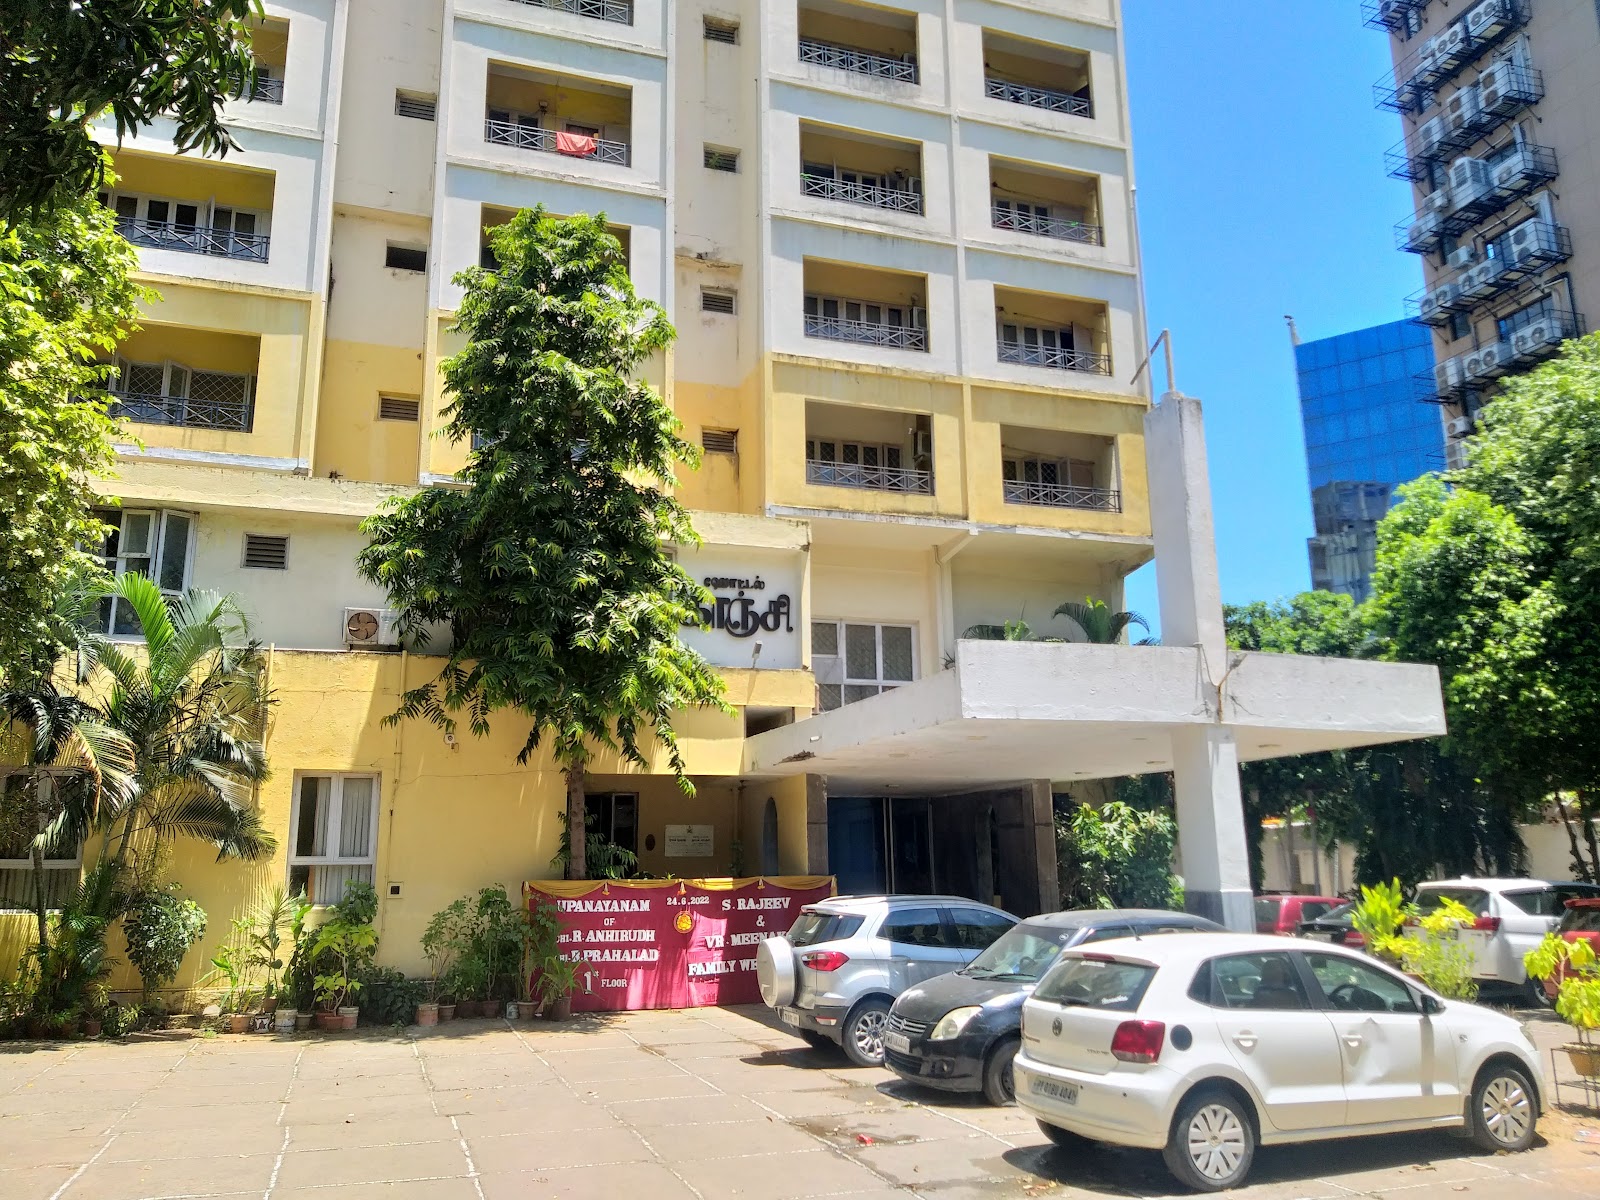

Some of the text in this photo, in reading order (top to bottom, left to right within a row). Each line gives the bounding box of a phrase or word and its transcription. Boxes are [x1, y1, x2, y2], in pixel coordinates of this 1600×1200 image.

[557, 899, 651, 913] UPANAYANAM
[666, 896, 710, 905] 24.6.2022
[603, 918, 616, 926] OF
[756, 915, 766, 927] &
[688, 960, 736, 976] FAMILY
[601, 978, 628, 988] FLOOR
